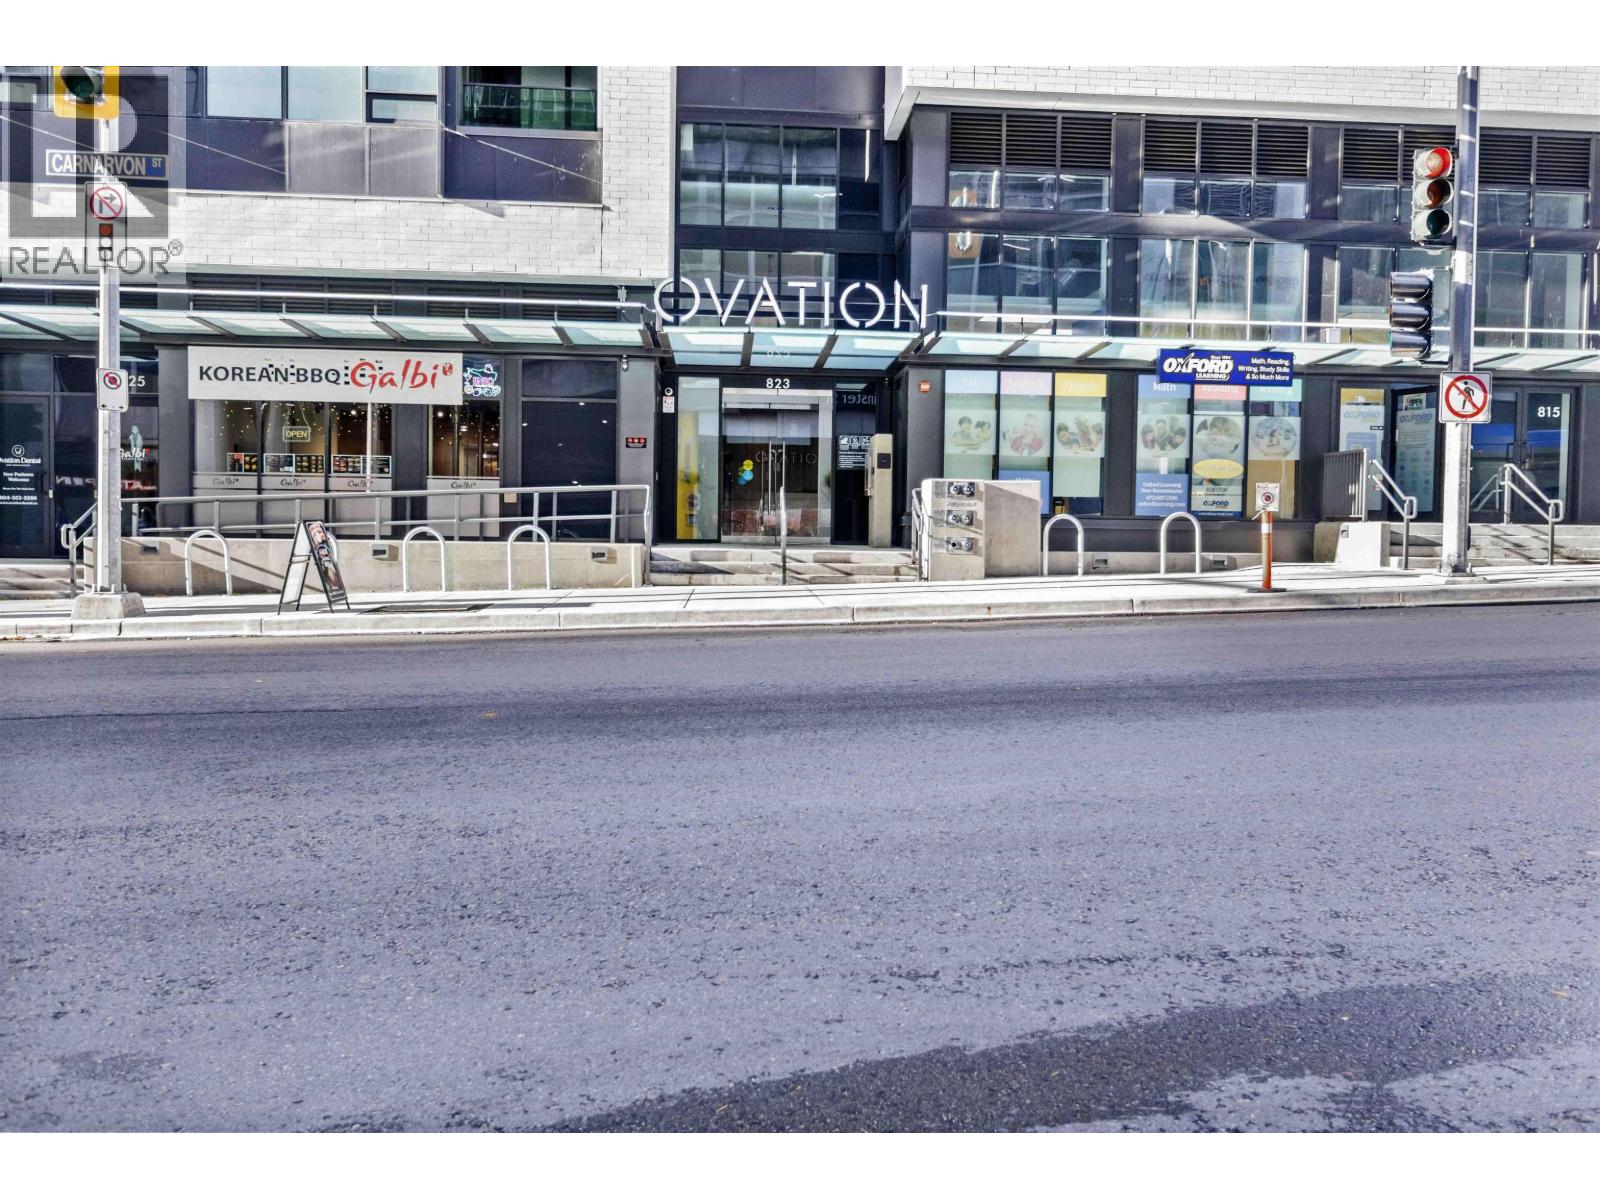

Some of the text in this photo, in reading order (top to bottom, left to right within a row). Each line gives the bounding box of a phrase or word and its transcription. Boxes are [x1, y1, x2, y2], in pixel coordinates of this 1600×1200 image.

[51, 154, 163, 176] CARNARVON ST
[653, 276, 928, 328] OVATION
[1163, 354, 1233, 373] OXFORD
[1259, 366, 1275, 374] Study
[128, 375, 146, 387] 25
[199, 365, 341, 385] KOREAN BBQ
[351, 358, 440, 393] Galbi
[766, 378, 790, 389] 823
[1537, 406, 1560, 418] 815
[347, 480, 373, 488] Galb
